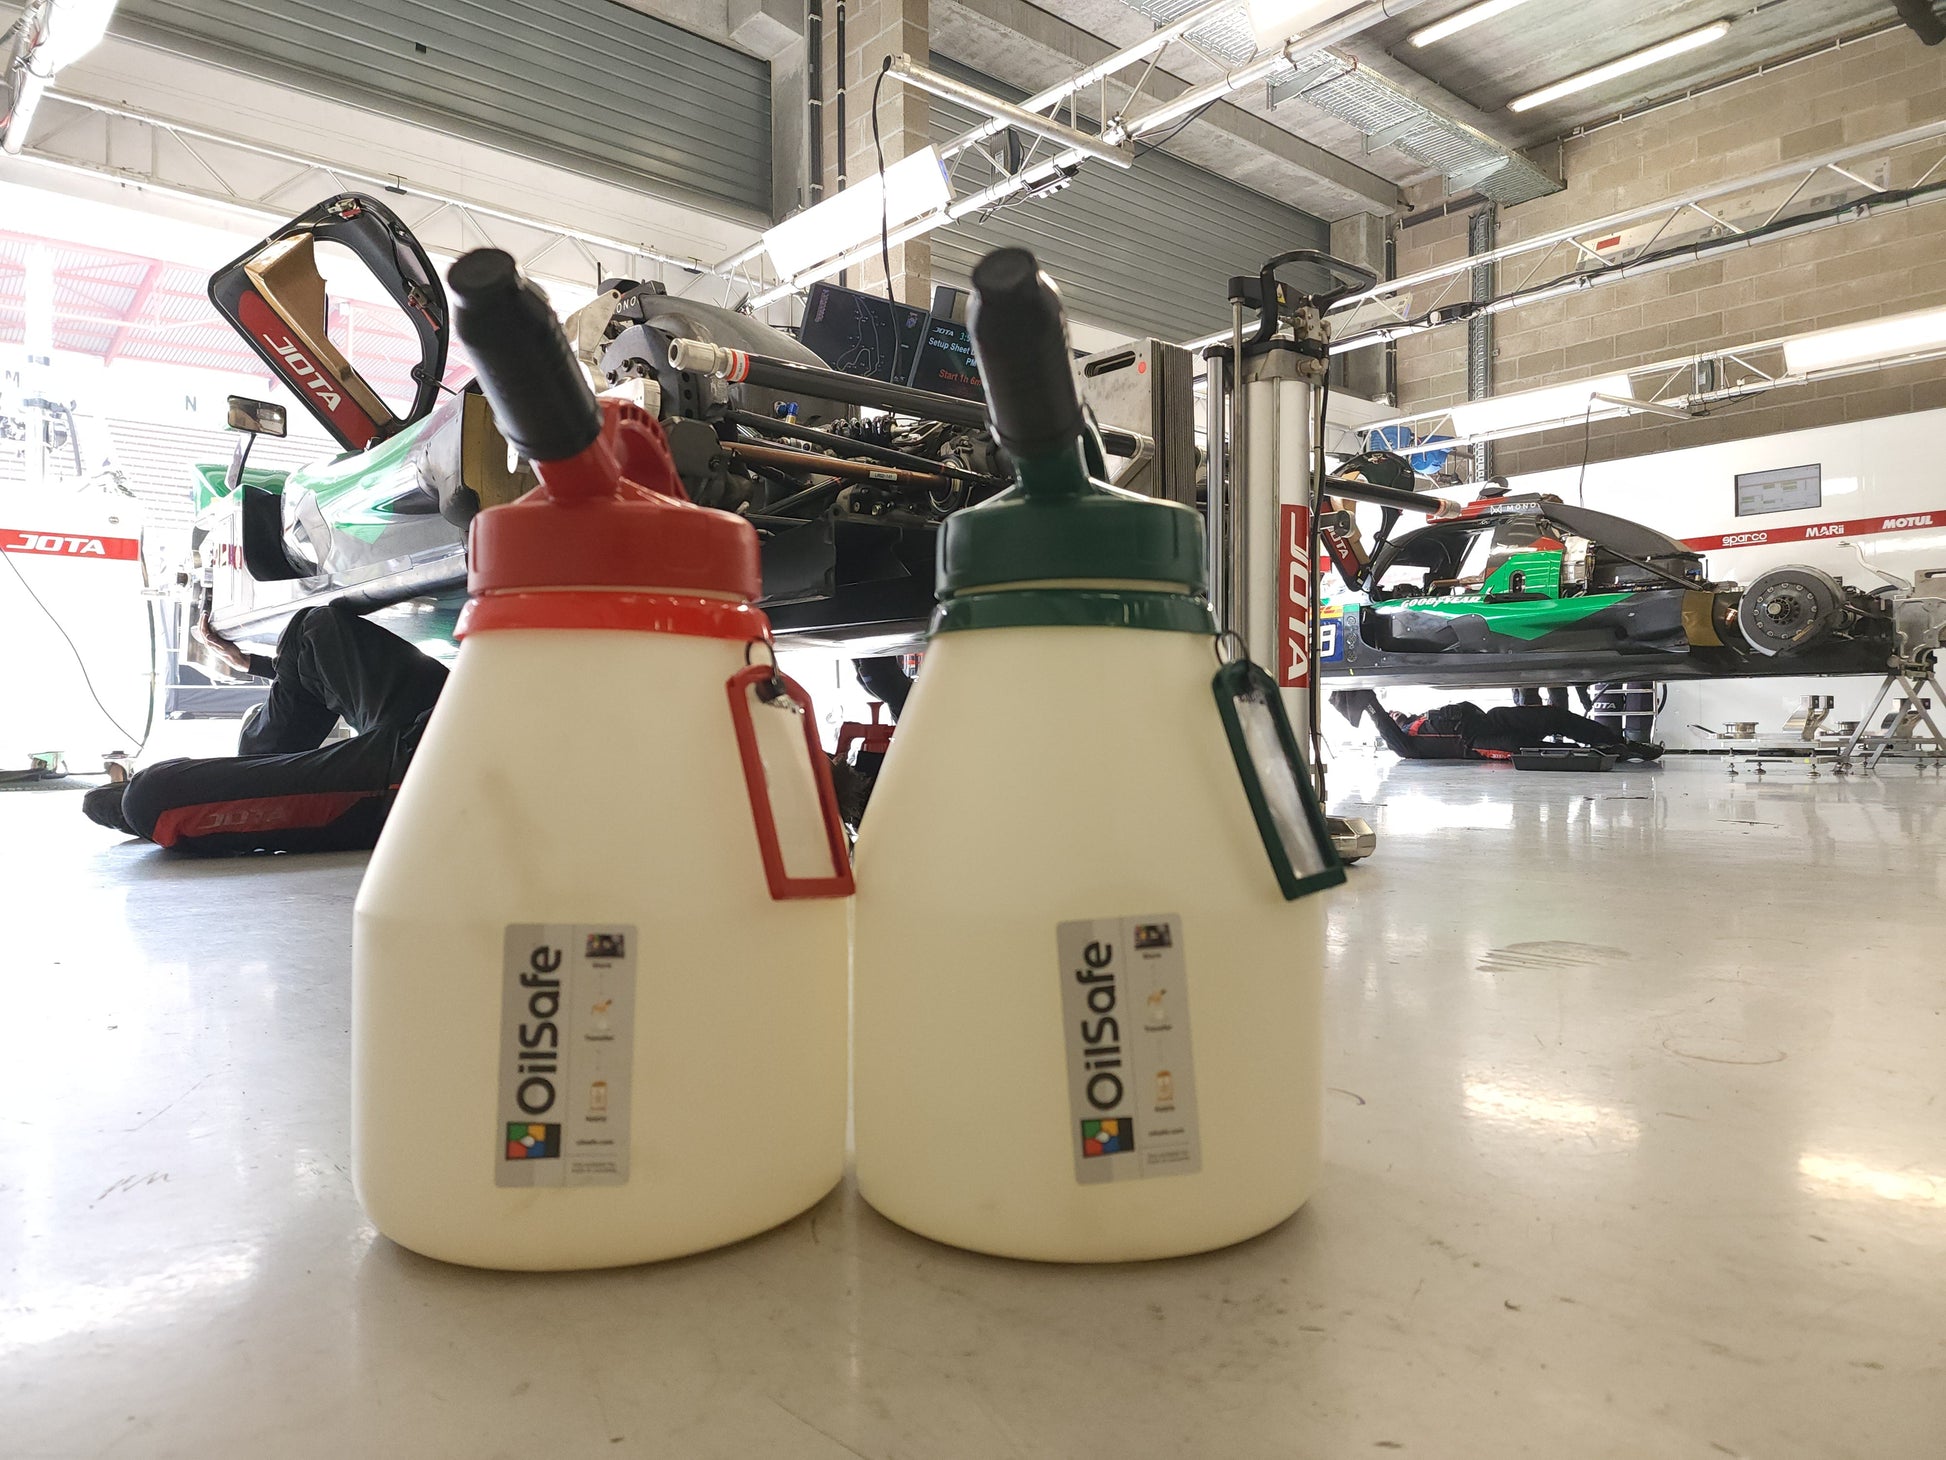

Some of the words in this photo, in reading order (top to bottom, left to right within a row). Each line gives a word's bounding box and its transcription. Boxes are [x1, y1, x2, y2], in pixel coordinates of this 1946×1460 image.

[616, 296, 640, 313] ONO
[932, 326, 954, 337] JOTA
[928, 337, 949, 350] Setup
[950, 342, 971, 355] Sheet
[262, 333, 342, 412] JOTA
[938, 368, 958, 381] Start
[185, 395, 197, 411] N
[1882, 515, 1934, 530] MOTUL
[6, 533, 106, 555] JOTA
[1722, 532, 1768, 547] sparco
[1287, 512, 1310, 681] JOTA
[1592, 702, 1617, 710] OTA
[516, 945, 562, 1115] OilSafe
[1076, 941, 1124, 1111] OilSafe
